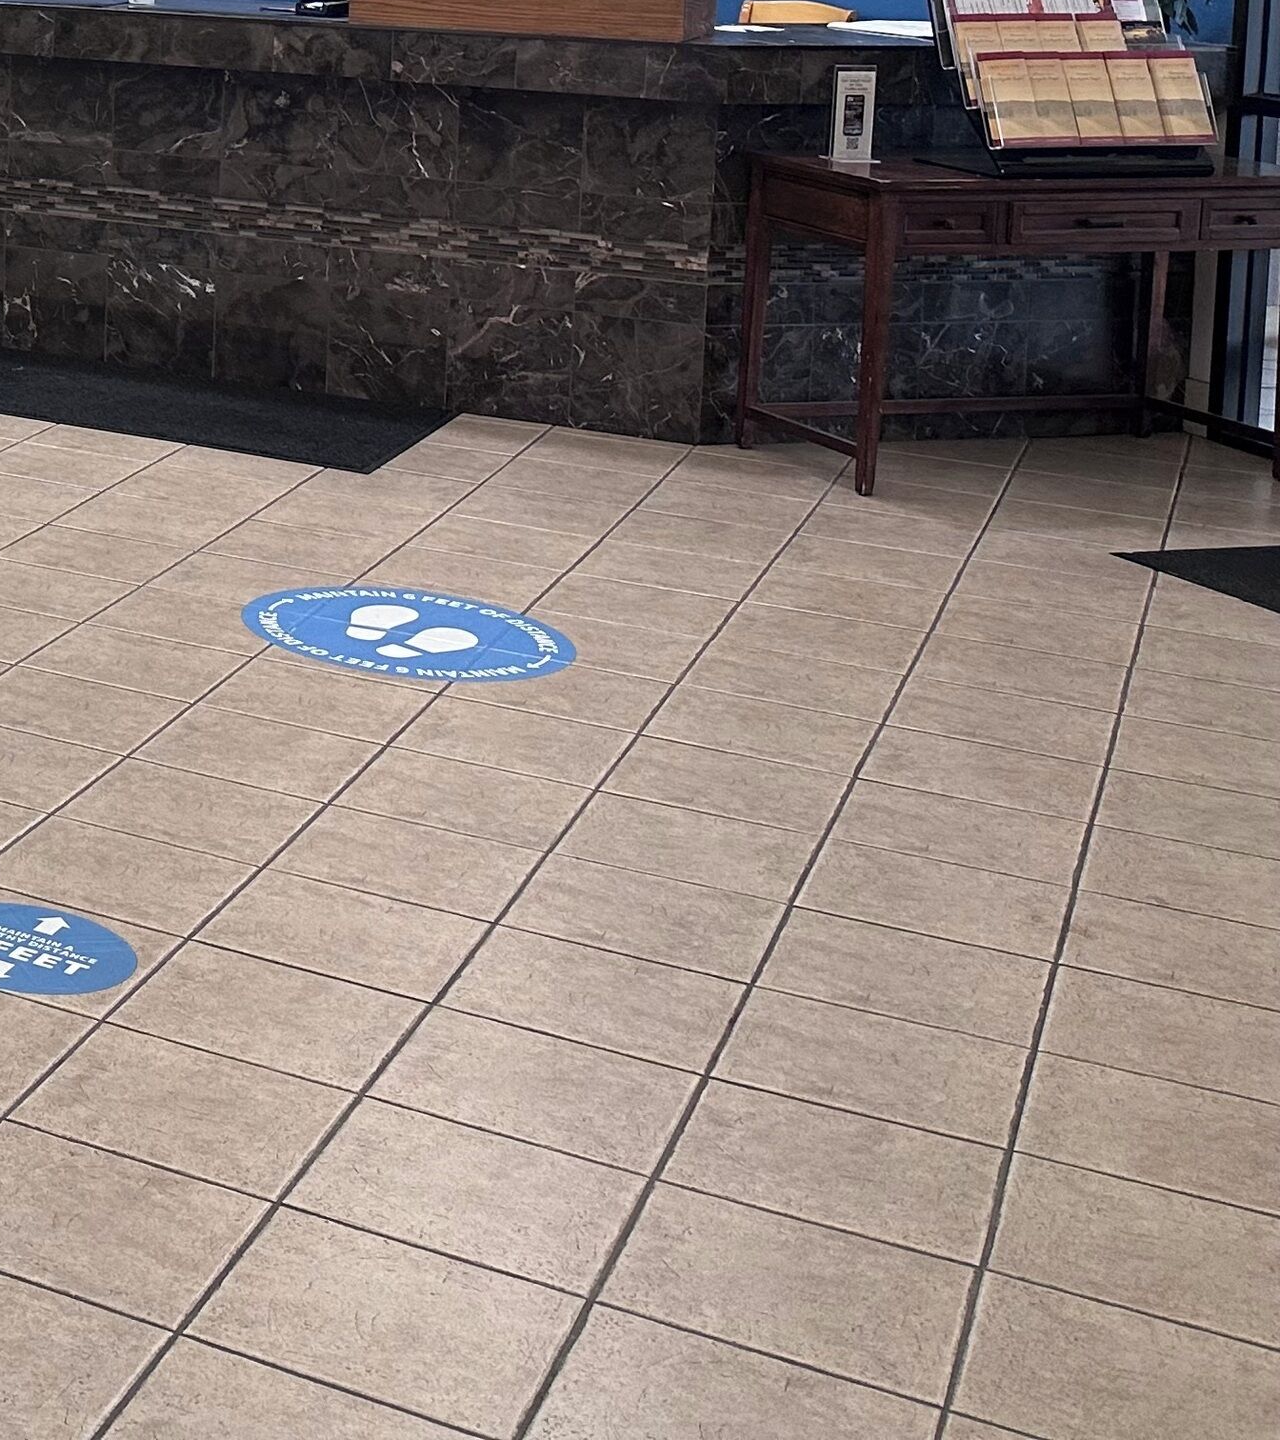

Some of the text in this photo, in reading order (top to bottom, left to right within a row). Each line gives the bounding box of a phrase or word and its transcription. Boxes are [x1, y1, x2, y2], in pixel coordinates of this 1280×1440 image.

[294, 590, 396, 601] MAINTAIN
[421, 596, 479, 610] FEET
[479, 609, 511, 620] OF
[505, 618, 558, 654] DISTANCE
[297, 645, 329, 656] OF
[329, 654, 389, 671] FEET
[395, 666, 409, 674] 6
[416, 665, 527, 678] MAINTAIN
[28, 940, 98, 964] DISTANCE
